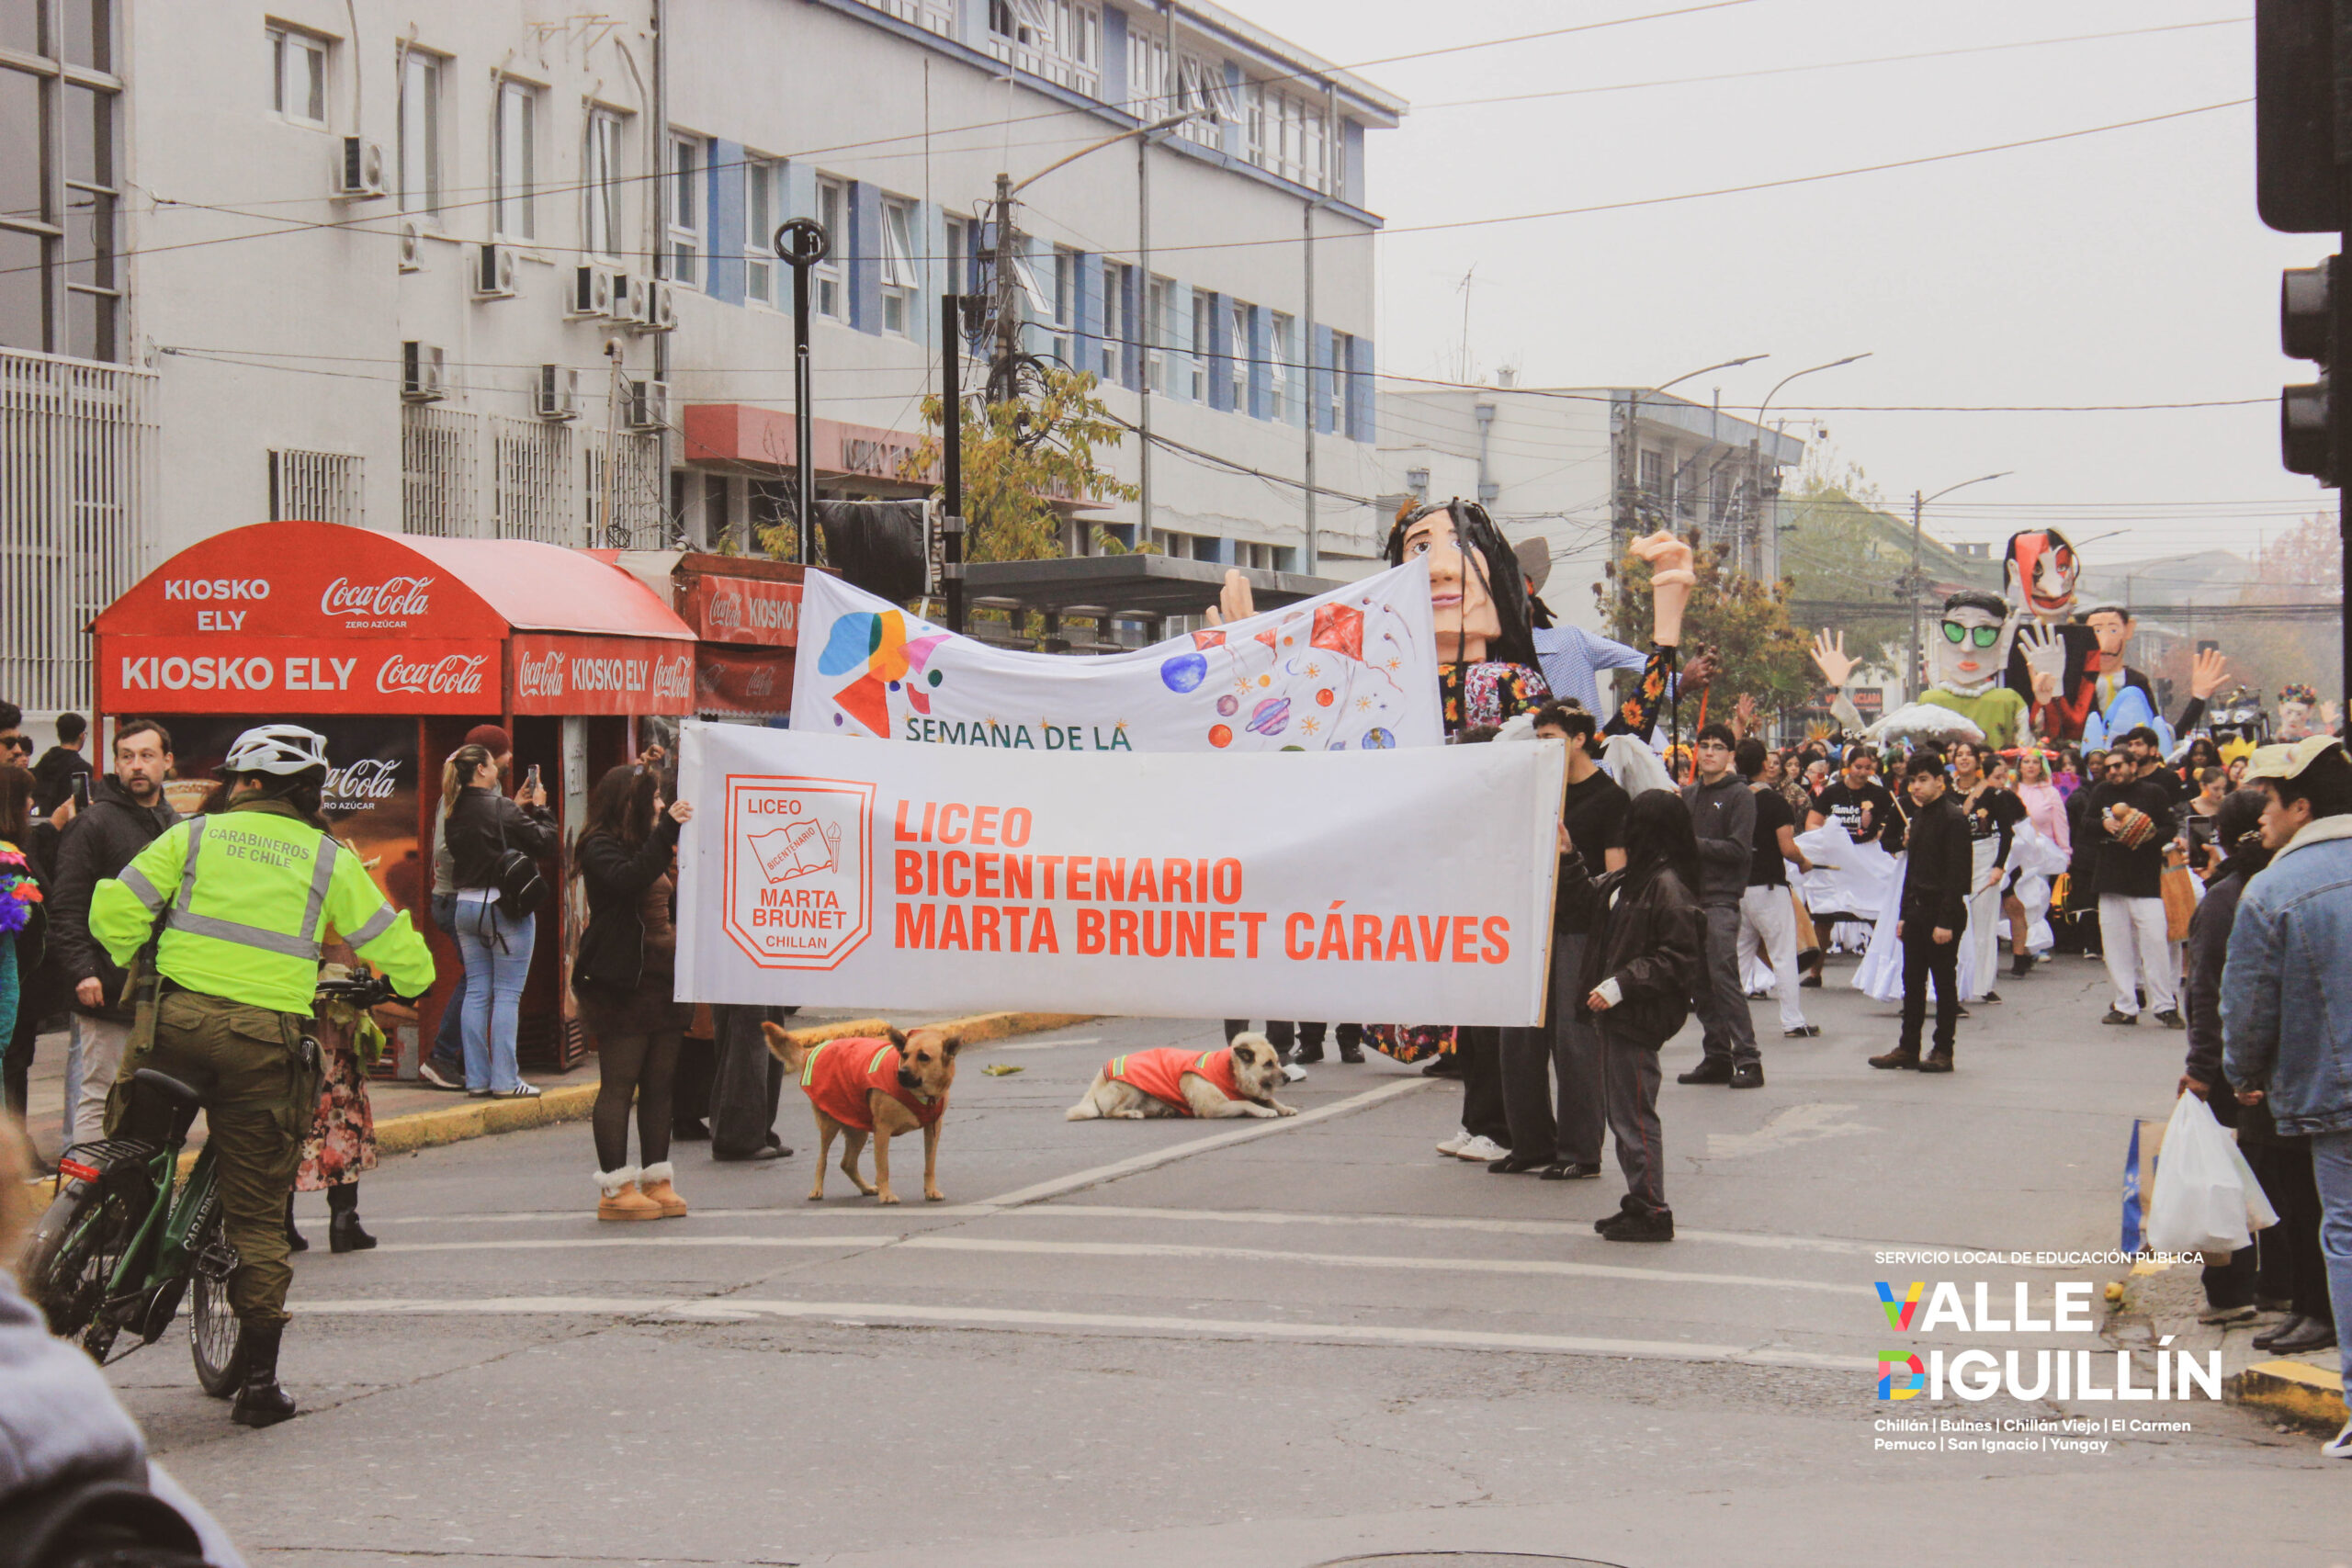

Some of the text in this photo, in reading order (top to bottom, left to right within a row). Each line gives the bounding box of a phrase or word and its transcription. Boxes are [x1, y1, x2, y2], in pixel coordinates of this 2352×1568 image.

[165, 579, 270, 600] KIOSKO
[322, 576, 435, 615] Coca-Cola
[198, 611, 246, 631] ELY
[370, 619, 407, 628] AZÚCAR
[709, 592, 742, 626] Coca-Cola
[749, 597, 794, 630] KIOSKO
[121, 654, 489, 694] KIOSKO ELY Coca-Cola
[520, 651, 565, 697] Coca-Cola
[571, 658, 623, 691] KIOSKO
[626, 660, 649, 692] ELY
[653, 655, 692, 698] Coca-Cola
[905, 716, 1133, 751] SEMANA DE LA
[338, 800, 375, 809] AZÚCAR
[748, 798, 802, 815] LICEO
[894, 799, 1033, 848] LICEO
[209, 829, 310, 860] CARABINEROS
[226, 844, 292, 869] DE CHILE
[767, 827, 816, 871] BICENTENARIO
[895, 849, 1243, 905] BICENTENARIO
[760, 888, 840, 908] MARTA
[752, 908, 847, 930] BRUNET
[895, 899, 1510, 964] MARTA BRUNET CÁRAVES
[765, 935, 827, 949] CHILLAN
